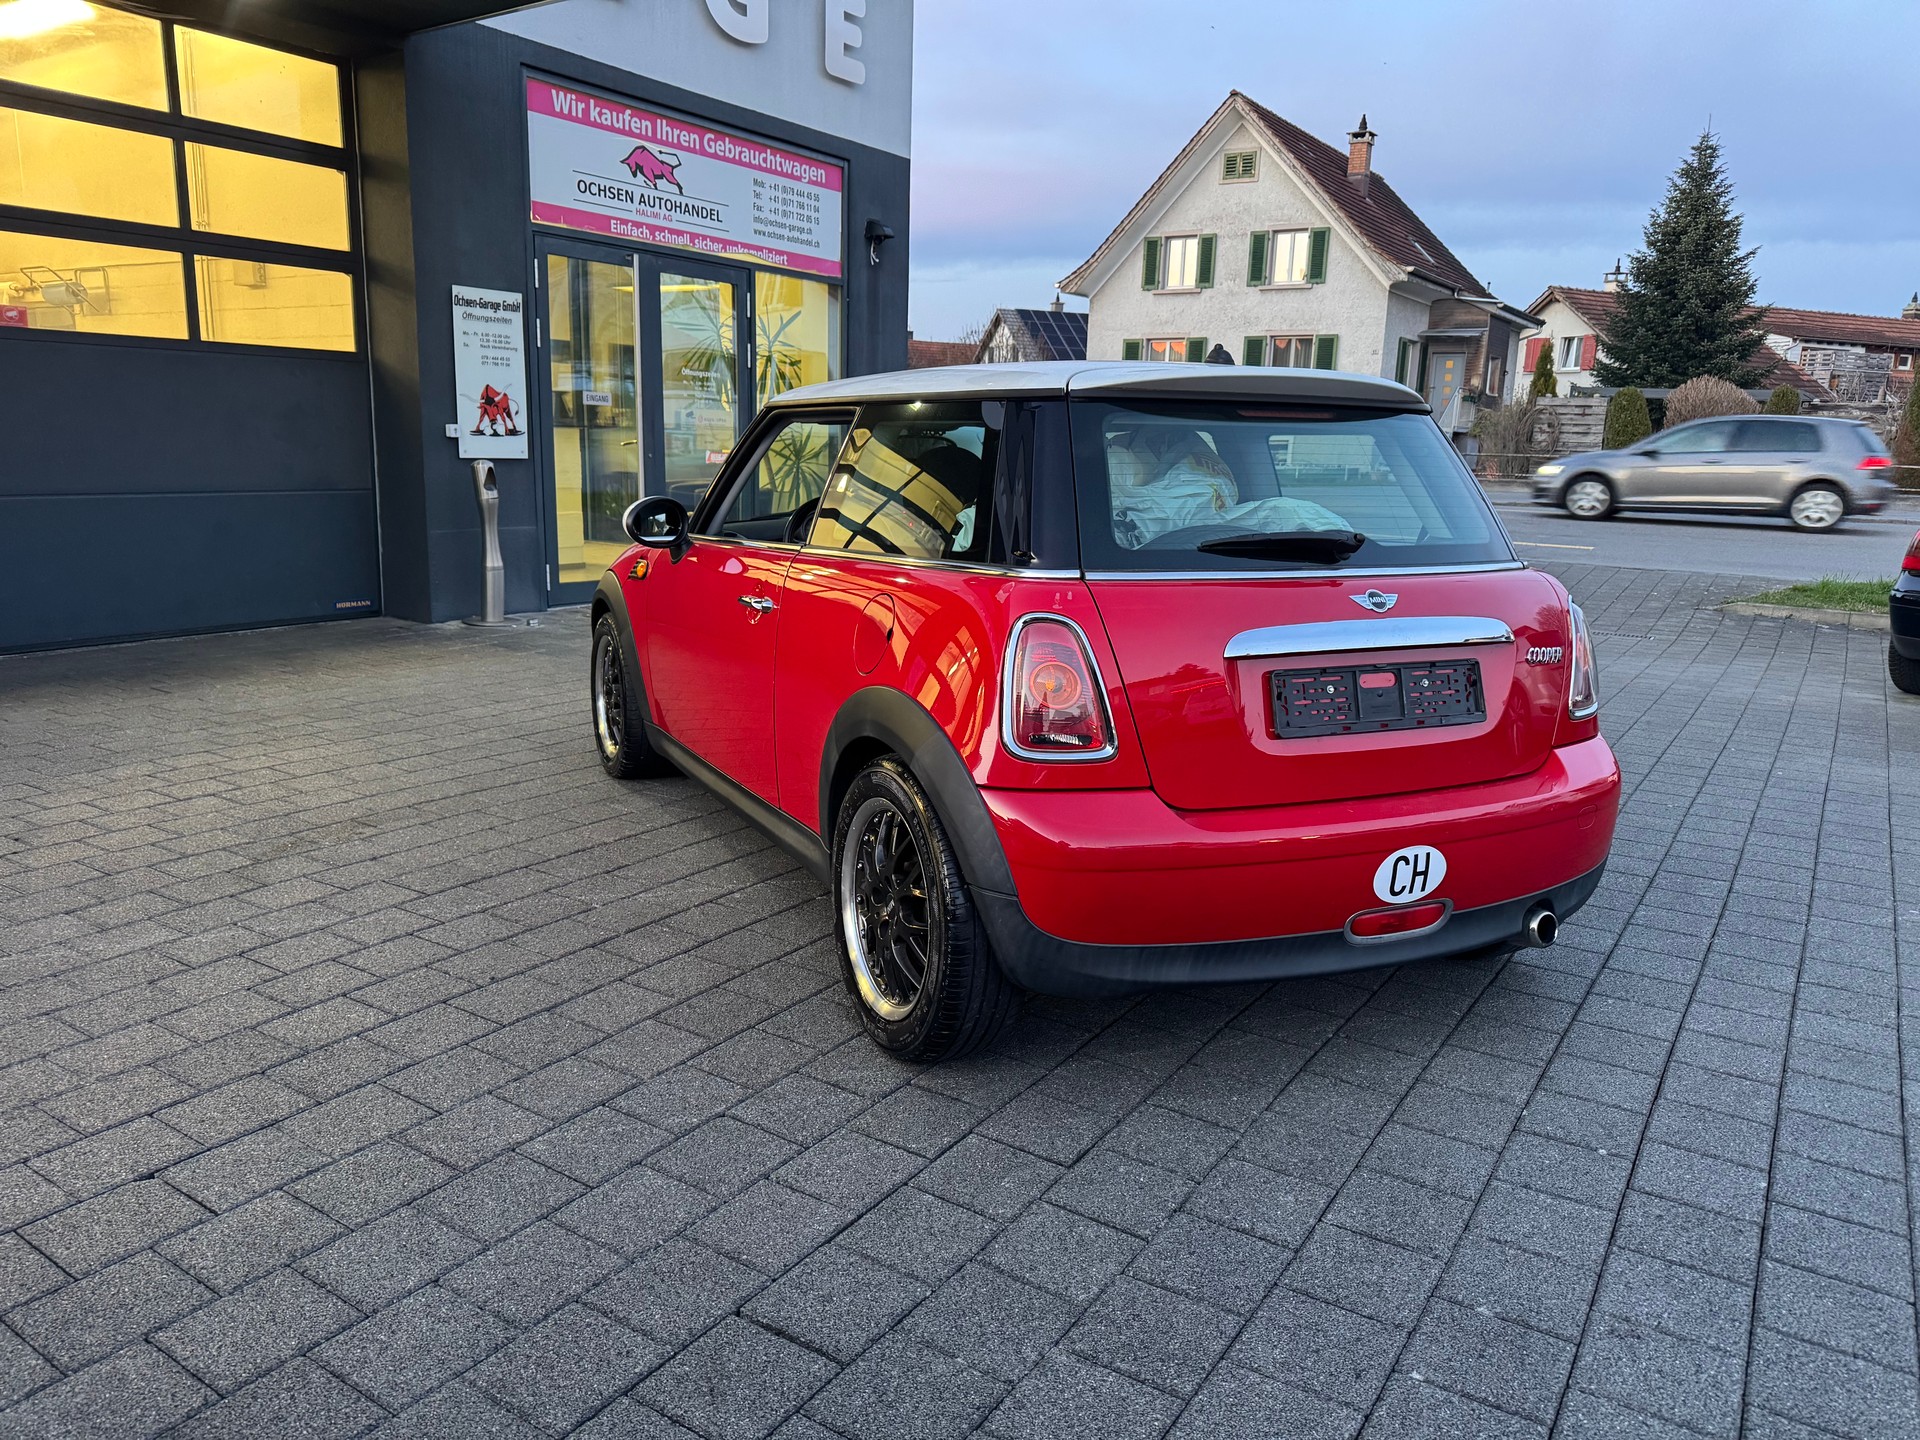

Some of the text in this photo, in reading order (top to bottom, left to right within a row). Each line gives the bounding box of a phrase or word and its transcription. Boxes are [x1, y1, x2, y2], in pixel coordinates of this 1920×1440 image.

[551, 89, 826, 184] Wir kaufen Ihren Gebrauchtwagen
[753, 178, 820, 202] Mob: +41 (0)79 444 45 55
[577, 180, 723, 223] OCHSEN AUTOHANDEL
[753, 190, 763, 200] Tel:
[768, 195, 779, 204] +41
[781, 197, 794, 208] (0)71
[806, 204, 812, 212] 11
[813, 205, 820, 214] 04
[636, 208, 672, 222] HALIMI AG
[753, 202, 820, 226] Fax: +41 (0)71 722 05 15
[610, 220, 653, 240] Einfach,
[753, 214, 812, 235] info@ochsen-garage.ch
[753, 228, 820, 248] www.ochsen-autohandel.ch
[454, 294, 520, 313] Ochsen-Garage GmbH
[462, 311, 512, 325] Öffnungszeiten
[586, 394, 608, 403] EINGANG
[1526, 646, 1562, 663] COOPER
[1389, 852, 1430, 897] CH
